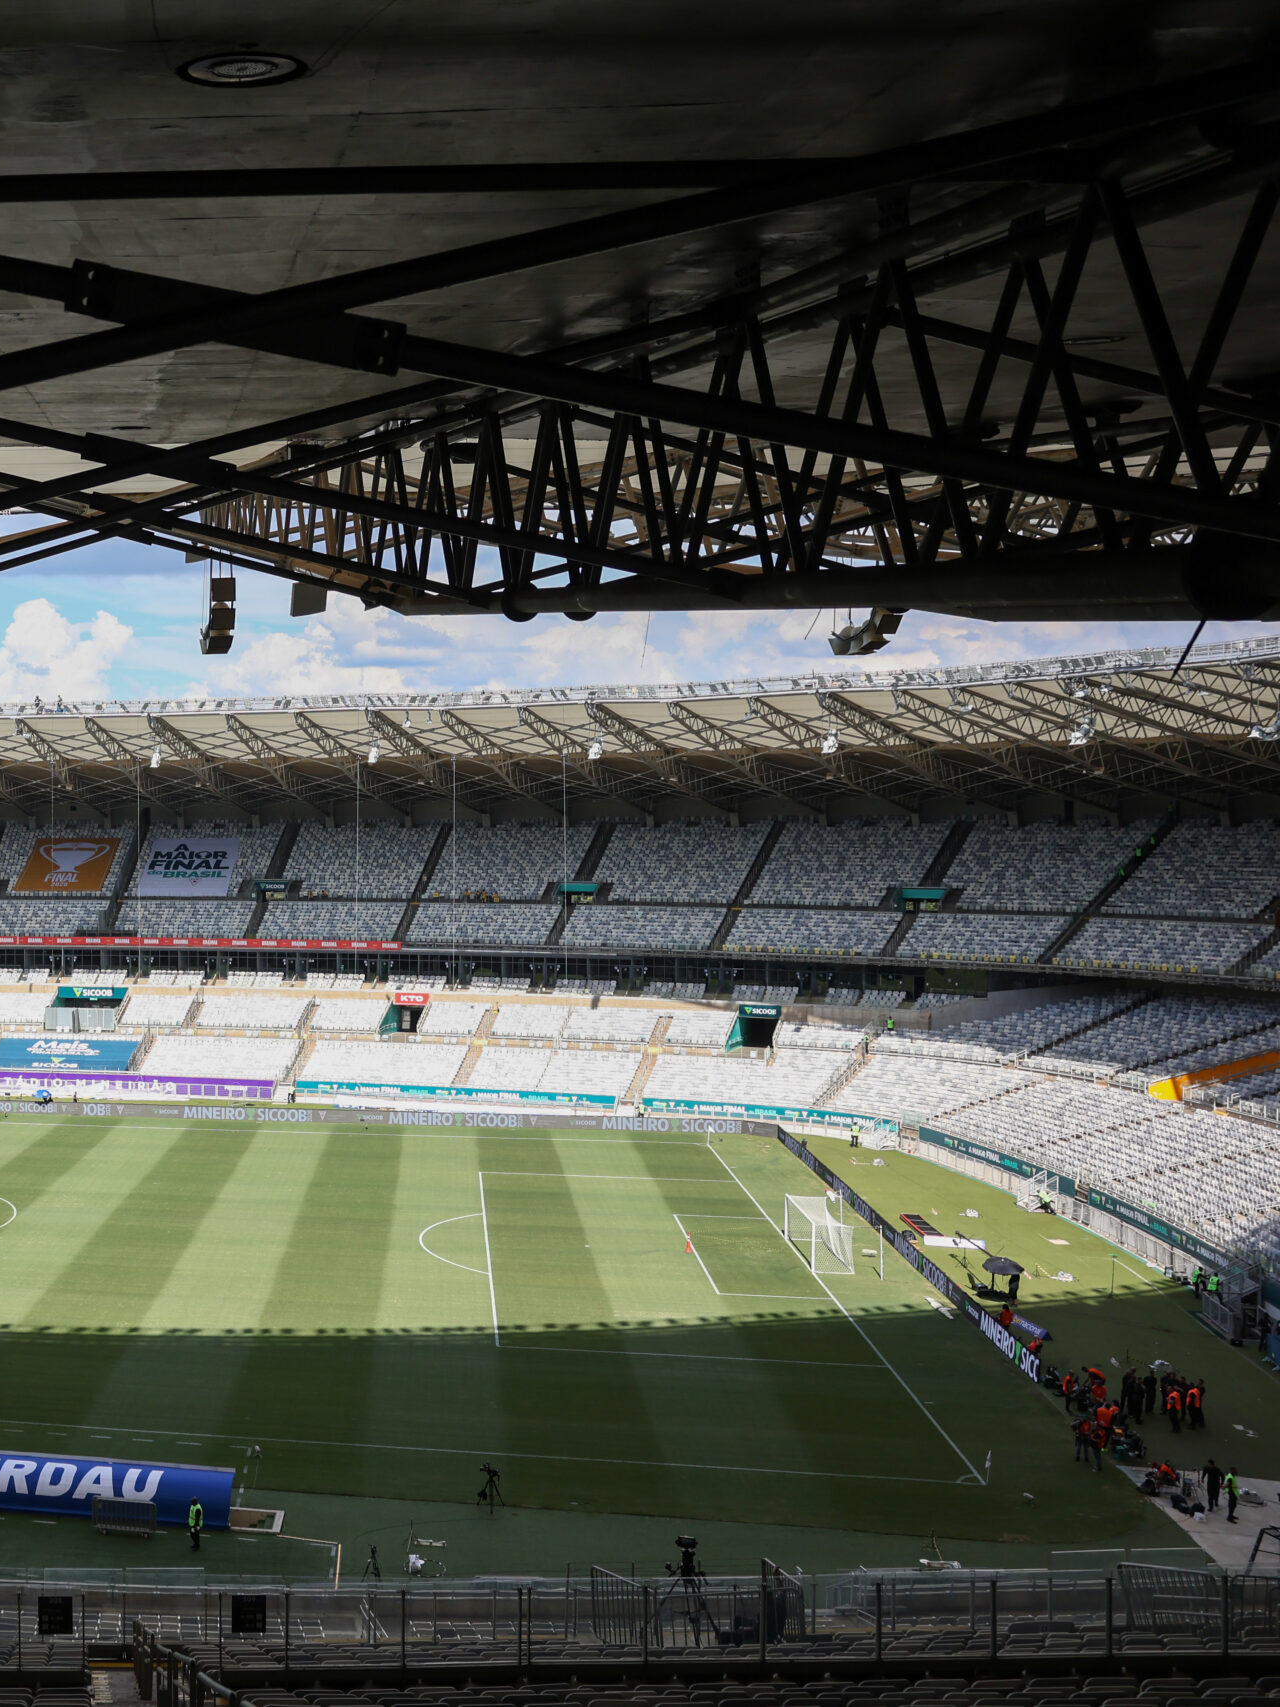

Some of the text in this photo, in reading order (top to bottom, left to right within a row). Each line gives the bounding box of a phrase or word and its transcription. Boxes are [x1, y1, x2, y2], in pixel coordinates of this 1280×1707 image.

[174, 843, 190, 851] A
[153, 850, 228, 860] MAIOR
[148, 860, 230, 870] FINAL
[44, 872, 78, 882] FINAL
[162, 870, 227, 878] BRASIL
[32, 1040, 89, 1049] Mais
[76, 1079, 176, 1092] MINEIRÃO
[20, 1103, 53, 1113] SICOOB
[183, 1106, 306, 1122] MINEIRO SICOOB
[388, 1112, 517, 1128] MINEIRO SICOOB
[602, 1116, 736, 1133] MINEIRO SICOOB
[894, 1232, 918, 1269] MINEIRO
[922, 1258, 944, 1291] SICOOB
[980, 1310, 1015, 1359] MINEIRO
